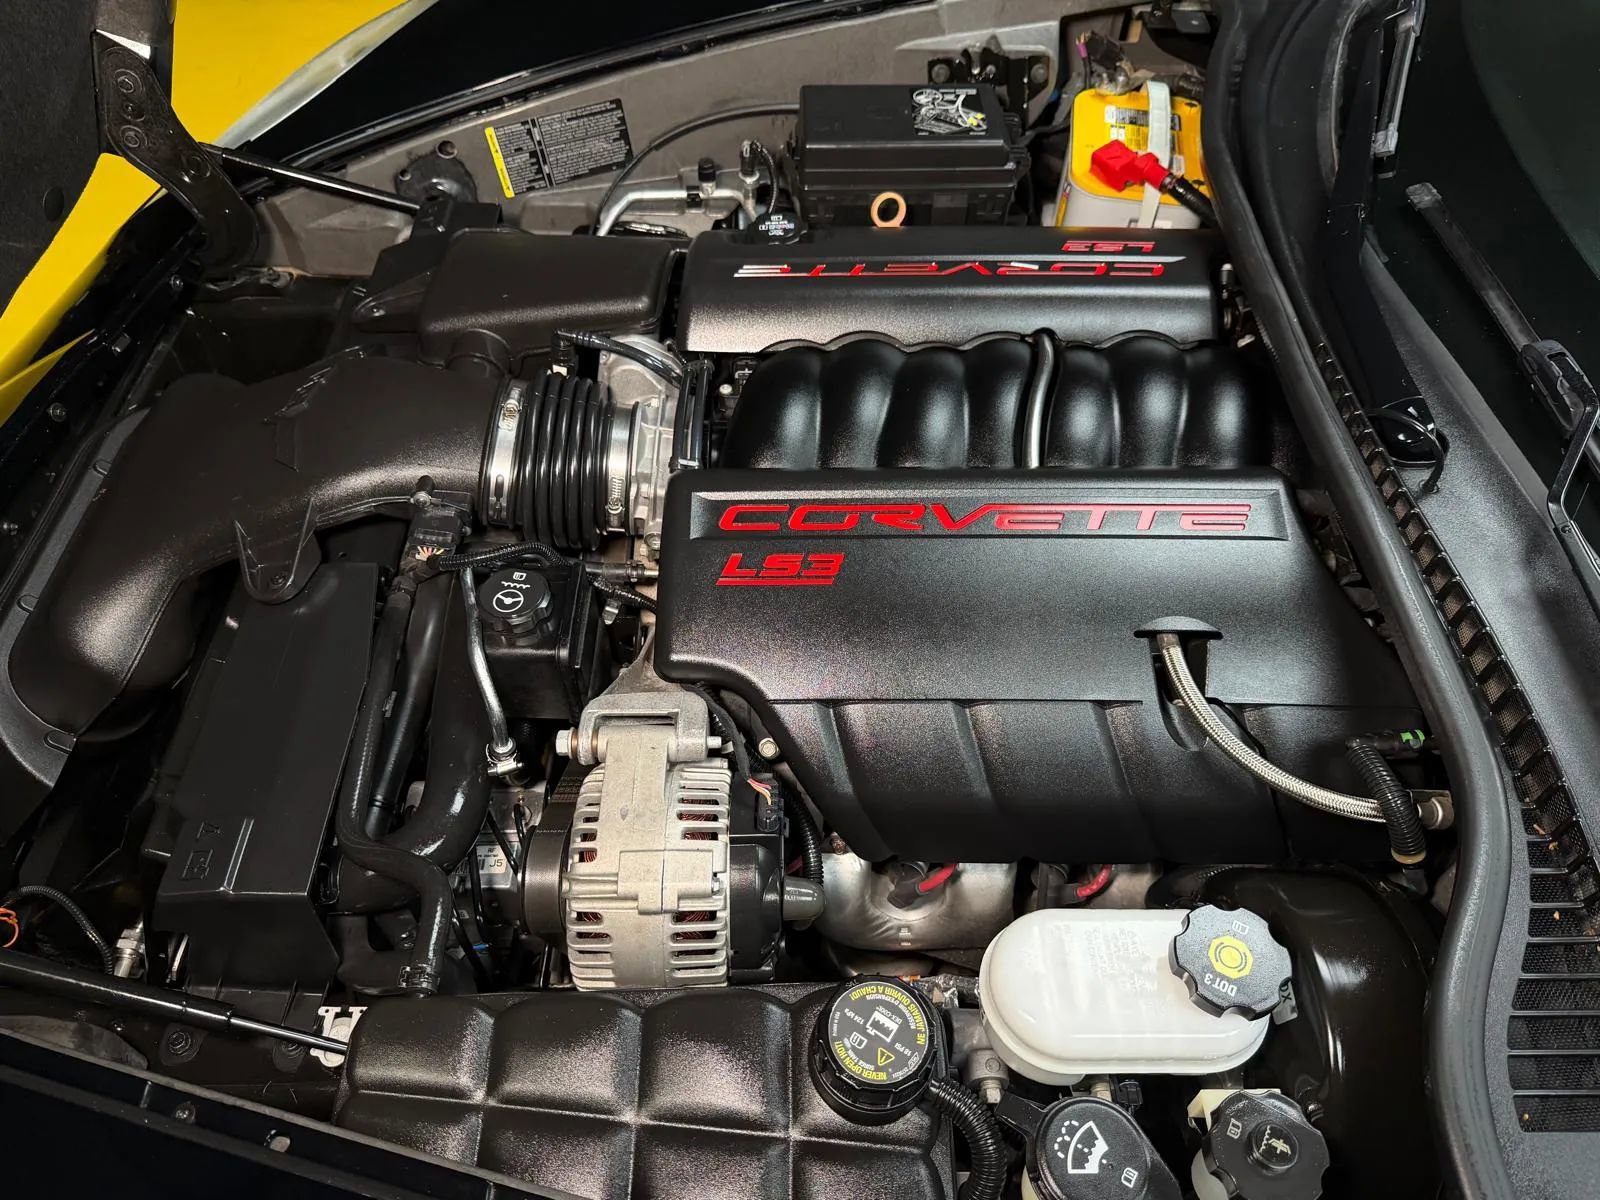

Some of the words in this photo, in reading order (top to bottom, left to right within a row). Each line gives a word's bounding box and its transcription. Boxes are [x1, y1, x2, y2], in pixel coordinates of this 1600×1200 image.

[733, 261, 1165, 278] CORVETTE
[717, 502, 1252, 533] CORVETTE
[717, 553, 845, 586] LS3
[1203, 972, 1213, 985] 3
[1212, 976, 1238, 997] DOT
[849, 985, 877, 1000] CHAUD!
[884, 987, 911, 1006] OUVRIR
[844, 1008, 856, 1019] kPa
[854, 1015, 865, 1025] 124
[907, 1004, 926, 1032] JAMAIS
[894, 1042, 906, 1053] PSI
[916, 1033, 926, 1045] NE
[834, 1040, 848, 1059] HOT!
[844, 1055, 862, 1073] OPEN
[863, 1068, 887, 1081] NEVER
